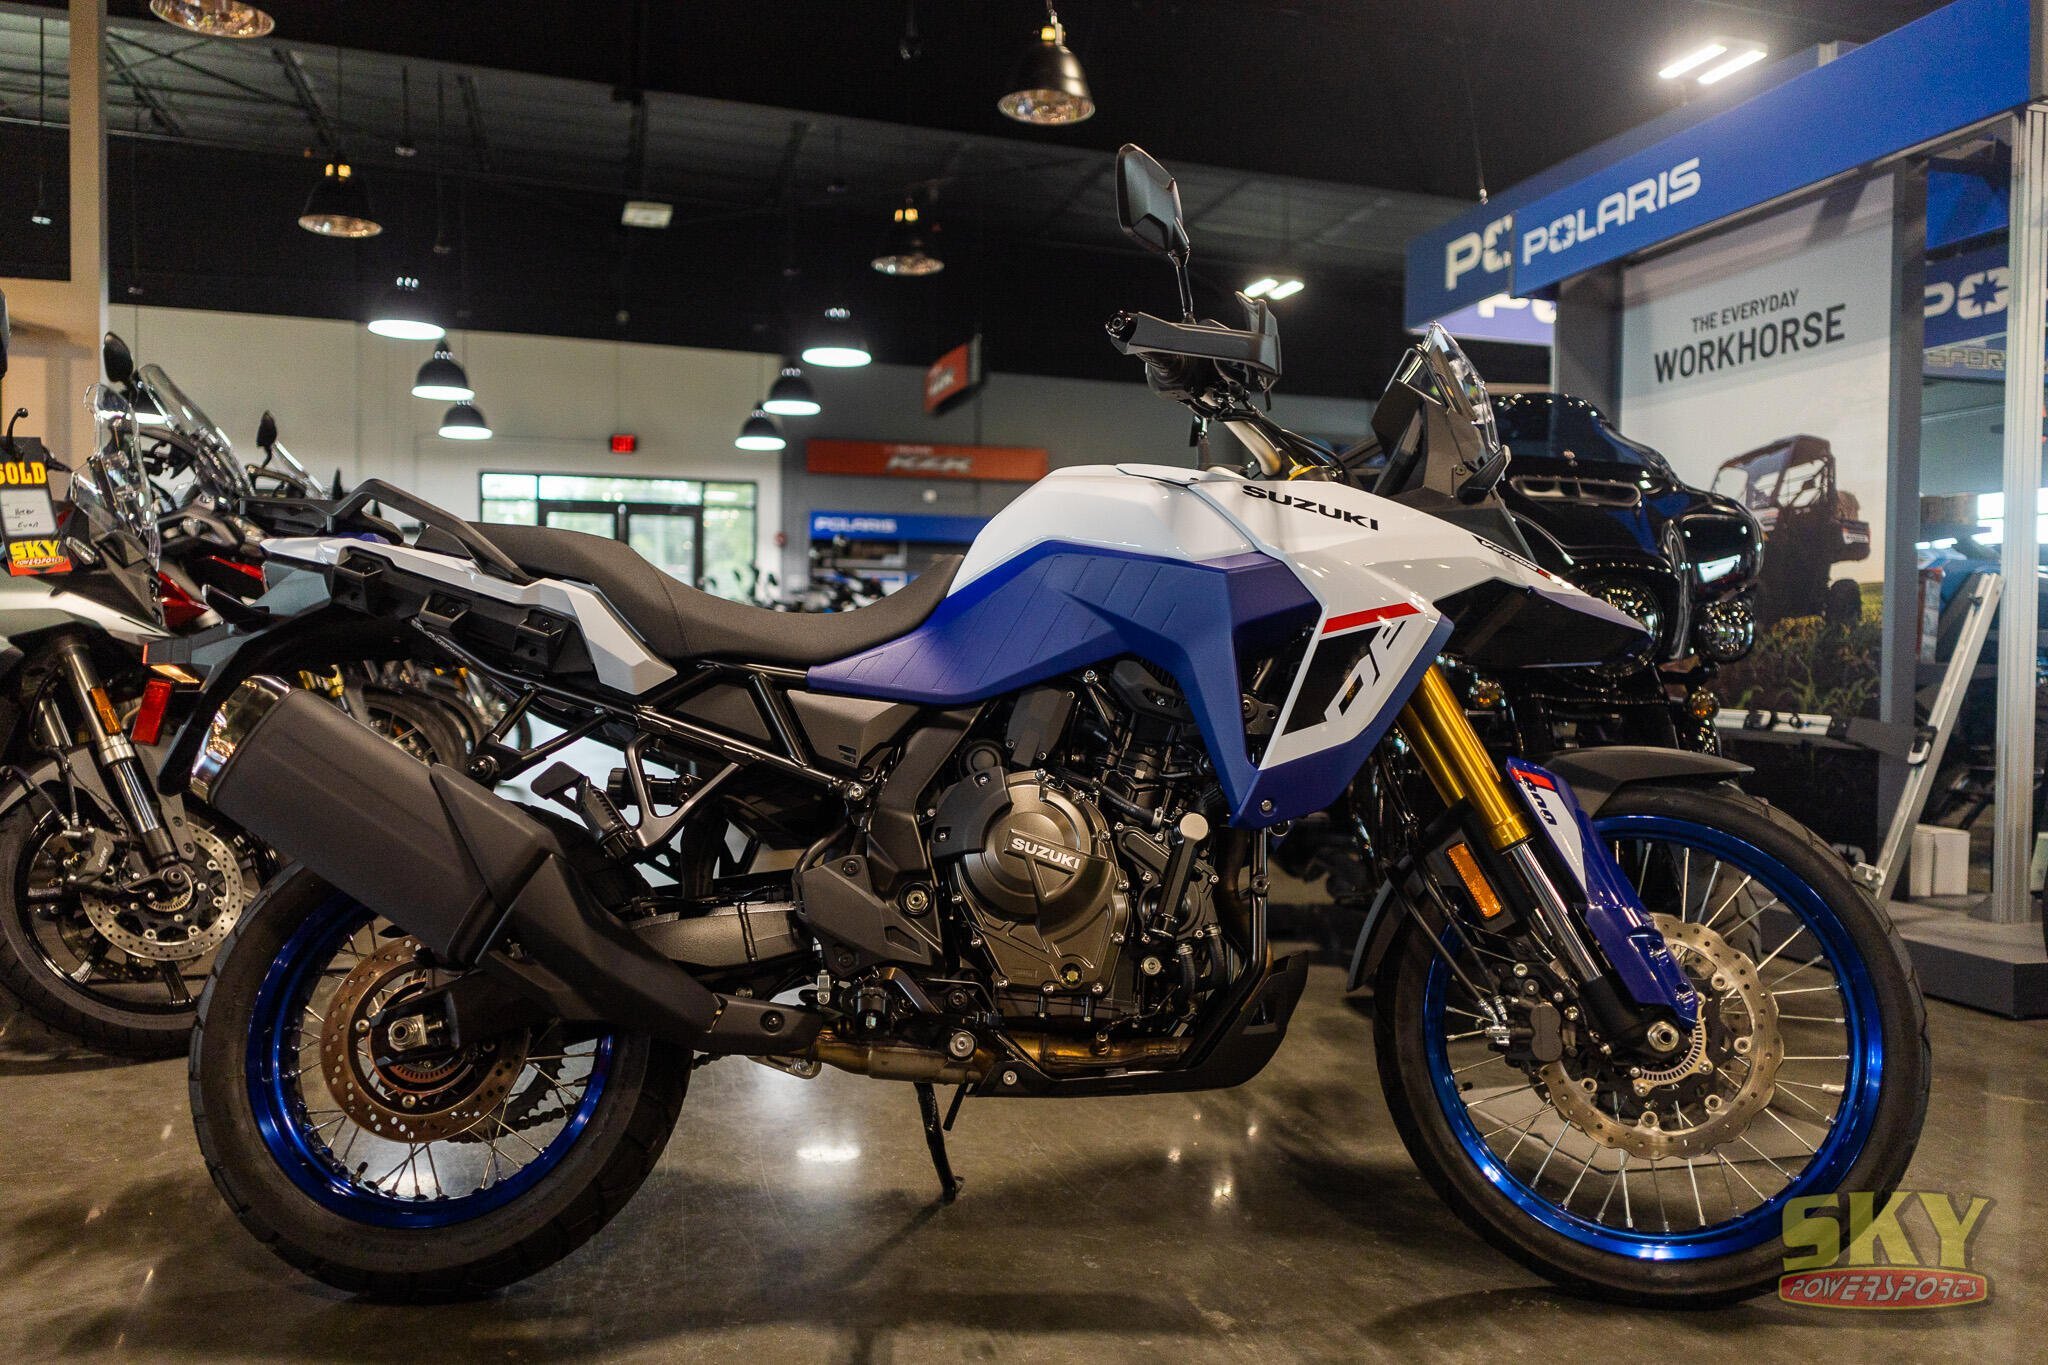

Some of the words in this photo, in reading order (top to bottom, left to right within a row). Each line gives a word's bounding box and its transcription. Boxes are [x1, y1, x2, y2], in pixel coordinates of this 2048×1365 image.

[1522, 157, 1702, 266] POLARIS
[1691, 312, 1717, 334] THE
[1721, 288, 1799, 325] EVERYDAY
[1654, 303, 1846, 383] WORKHORSE
[1242, 485, 1379, 531] SUZUKI
[10, 540, 60, 560] SKY
[1011, 838, 1080, 869] SUZUKI
